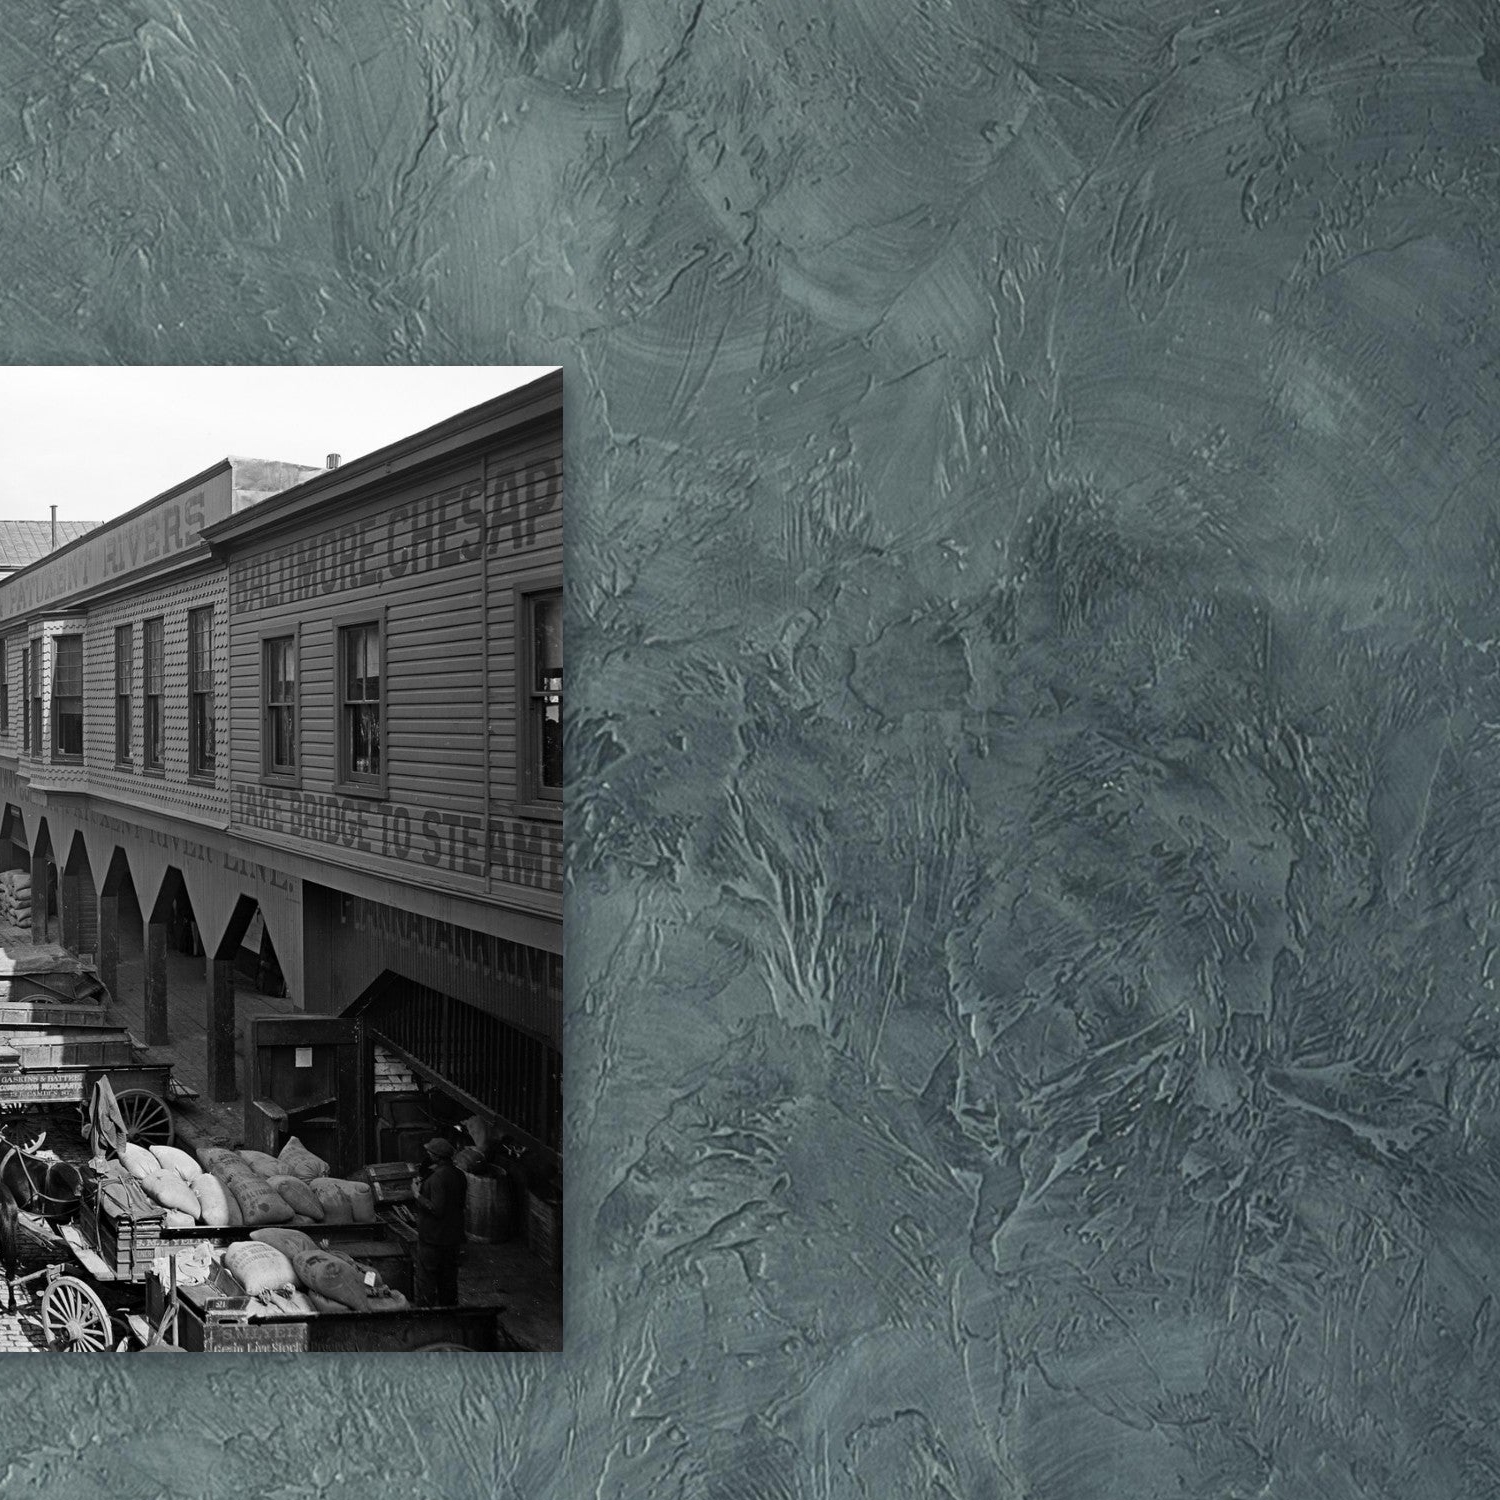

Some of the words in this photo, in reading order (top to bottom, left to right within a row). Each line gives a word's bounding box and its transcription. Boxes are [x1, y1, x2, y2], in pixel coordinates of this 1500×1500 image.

[103, 491, 205, 577] RIVERS
[235, 784, 284, 832] TAKE
[289, 793, 373, 851] BRIDGE
[377, 803, 411, 860] TO
